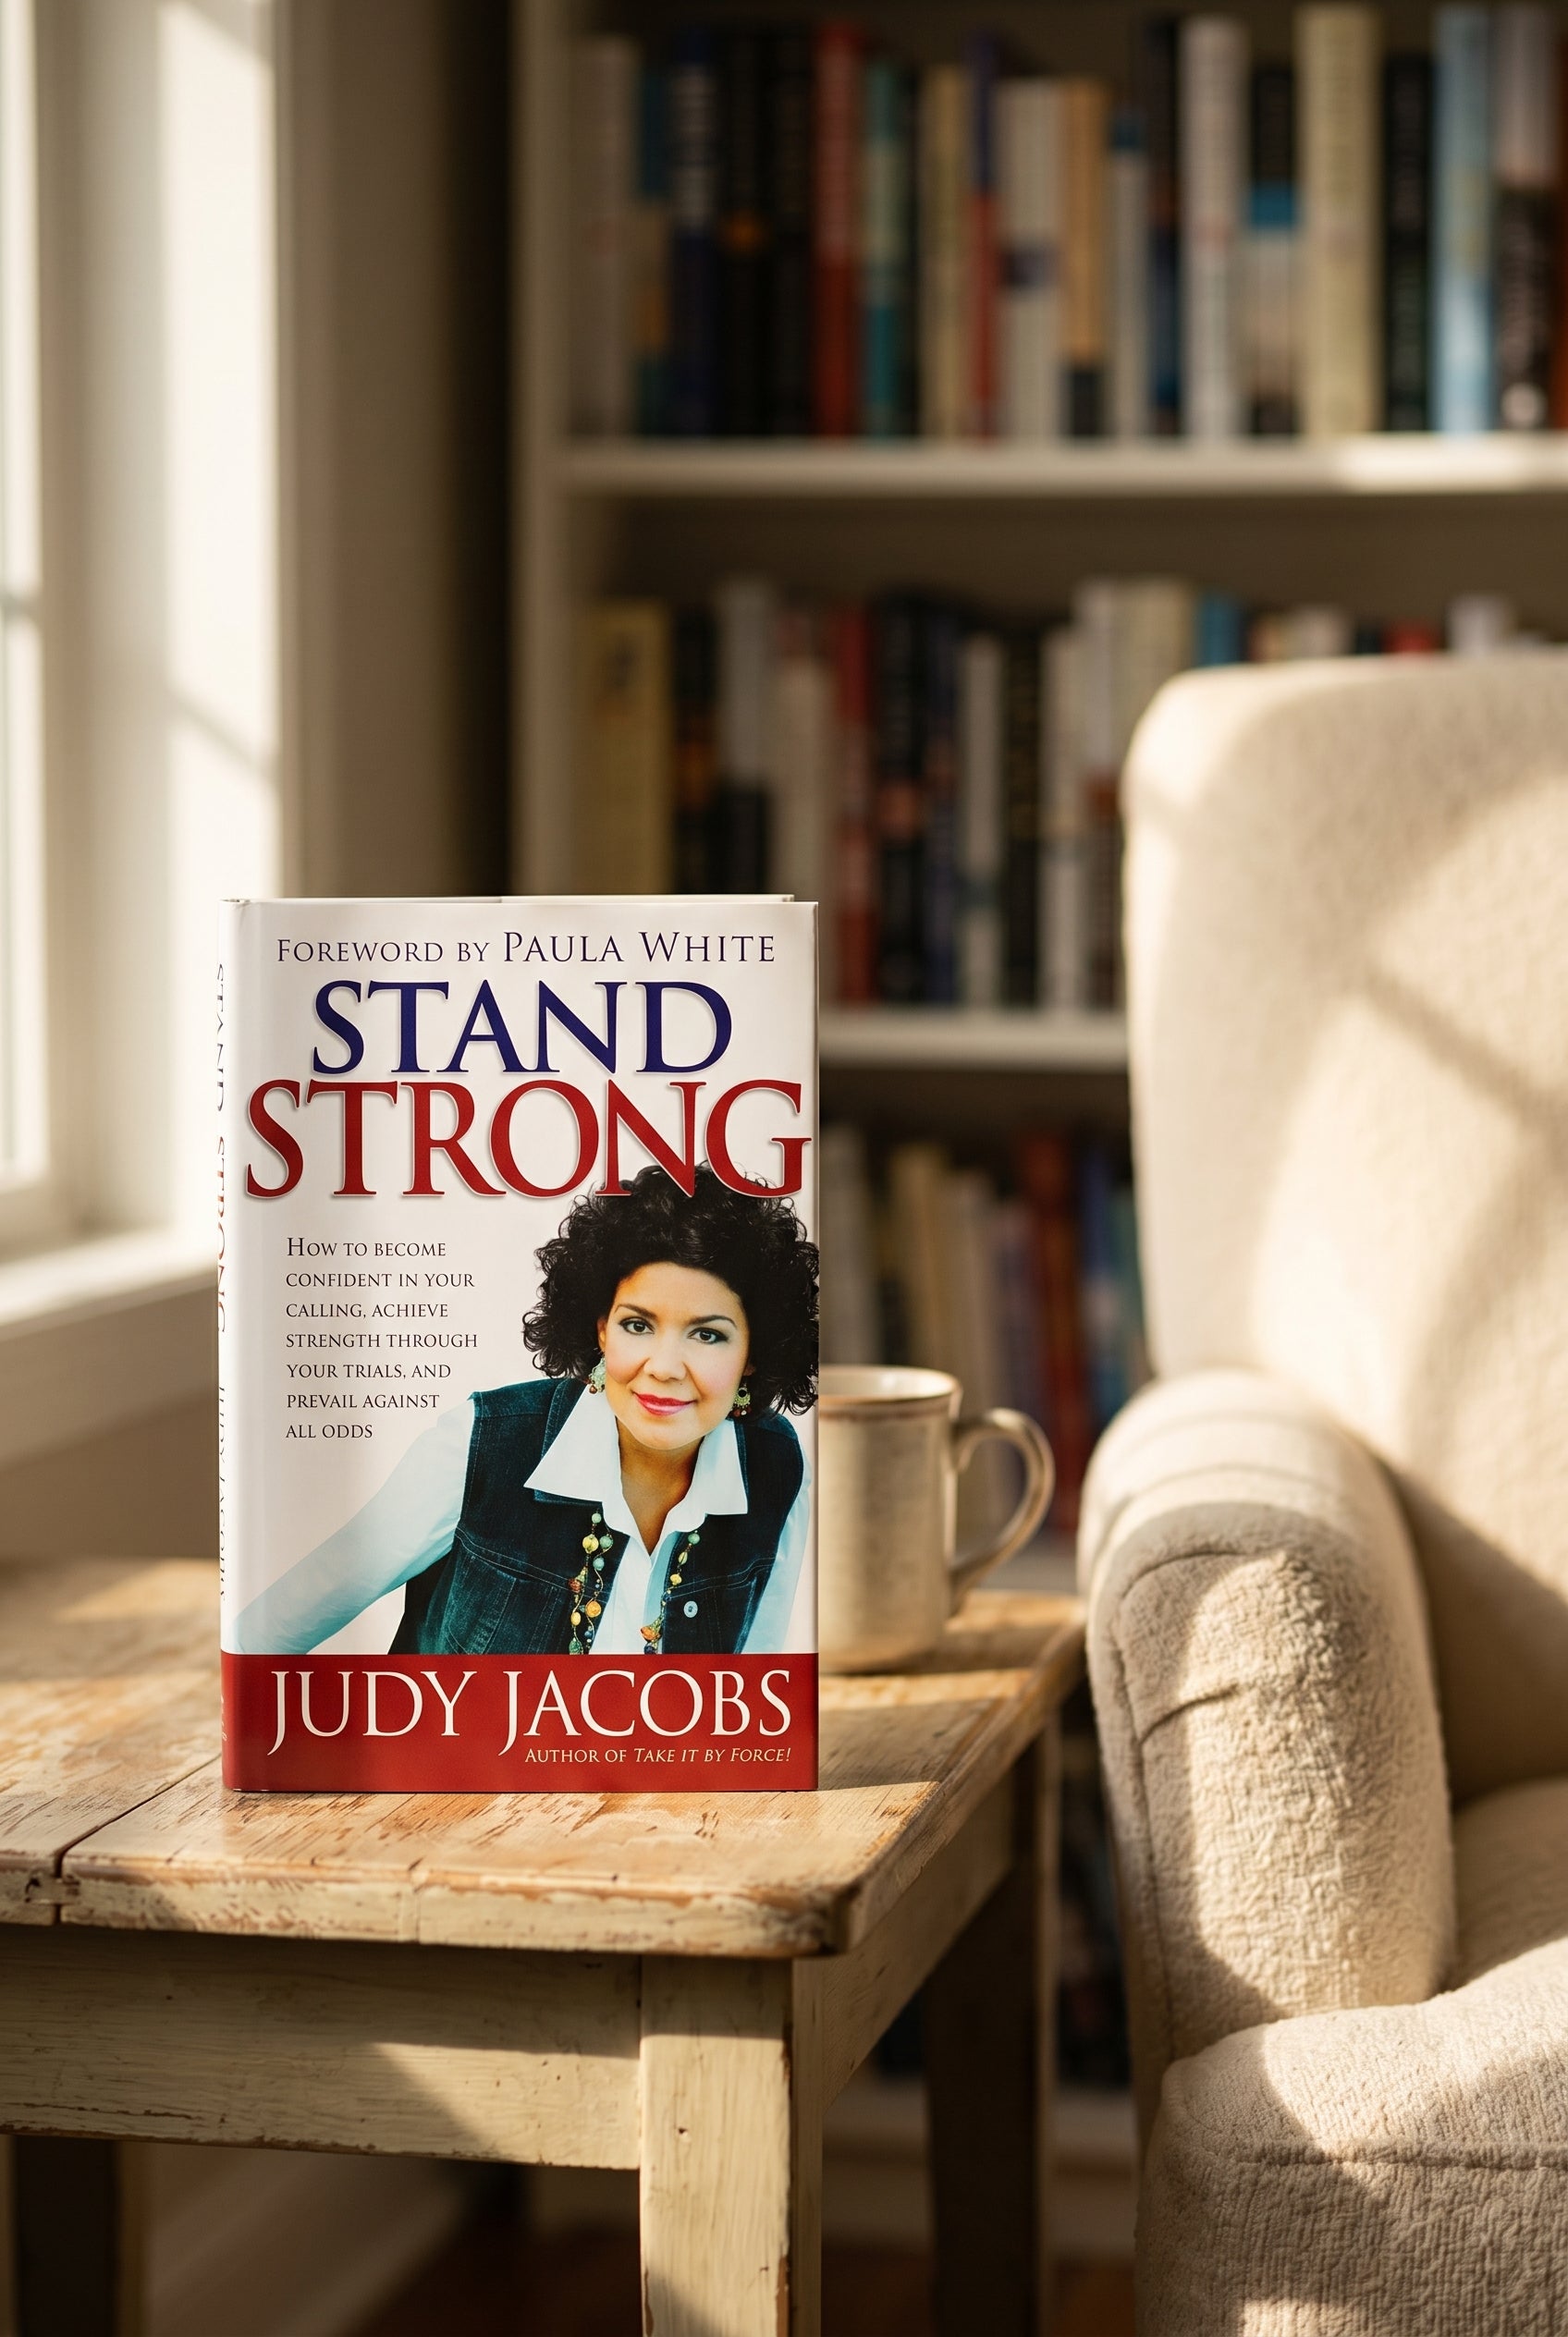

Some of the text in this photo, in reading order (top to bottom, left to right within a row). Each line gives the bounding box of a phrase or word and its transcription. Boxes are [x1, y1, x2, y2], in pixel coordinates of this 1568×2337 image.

[276, 931, 776, 962] FOREWORD BY PAULA WHITE
[312, 979, 733, 1074] STAND
[245, 1079, 813, 1198] STRONG
[287, 1237, 447, 1257] HOW TO BECOME
[286, 1273, 475, 1288] CONFIDENT IN YOUR
[286, 1303, 448, 1319] CALLING, ACHIEVE
[286, 1334, 478, 1348] STRENGTH THROUGH
[286, 1364, 451, 1380] YOUR TRIALS, AND
[287, 1394, 440, 1409] PREVAIL AGAINST
[286, 1425, 373, 1438] ALL ODDS
[267, 1670, 477, 1756] JUDY
[498, 1670, 791, 1756] JACOBS
[524, 1747, 792, 1763] AUTHOR OF TAKE IT BY FORCE!
